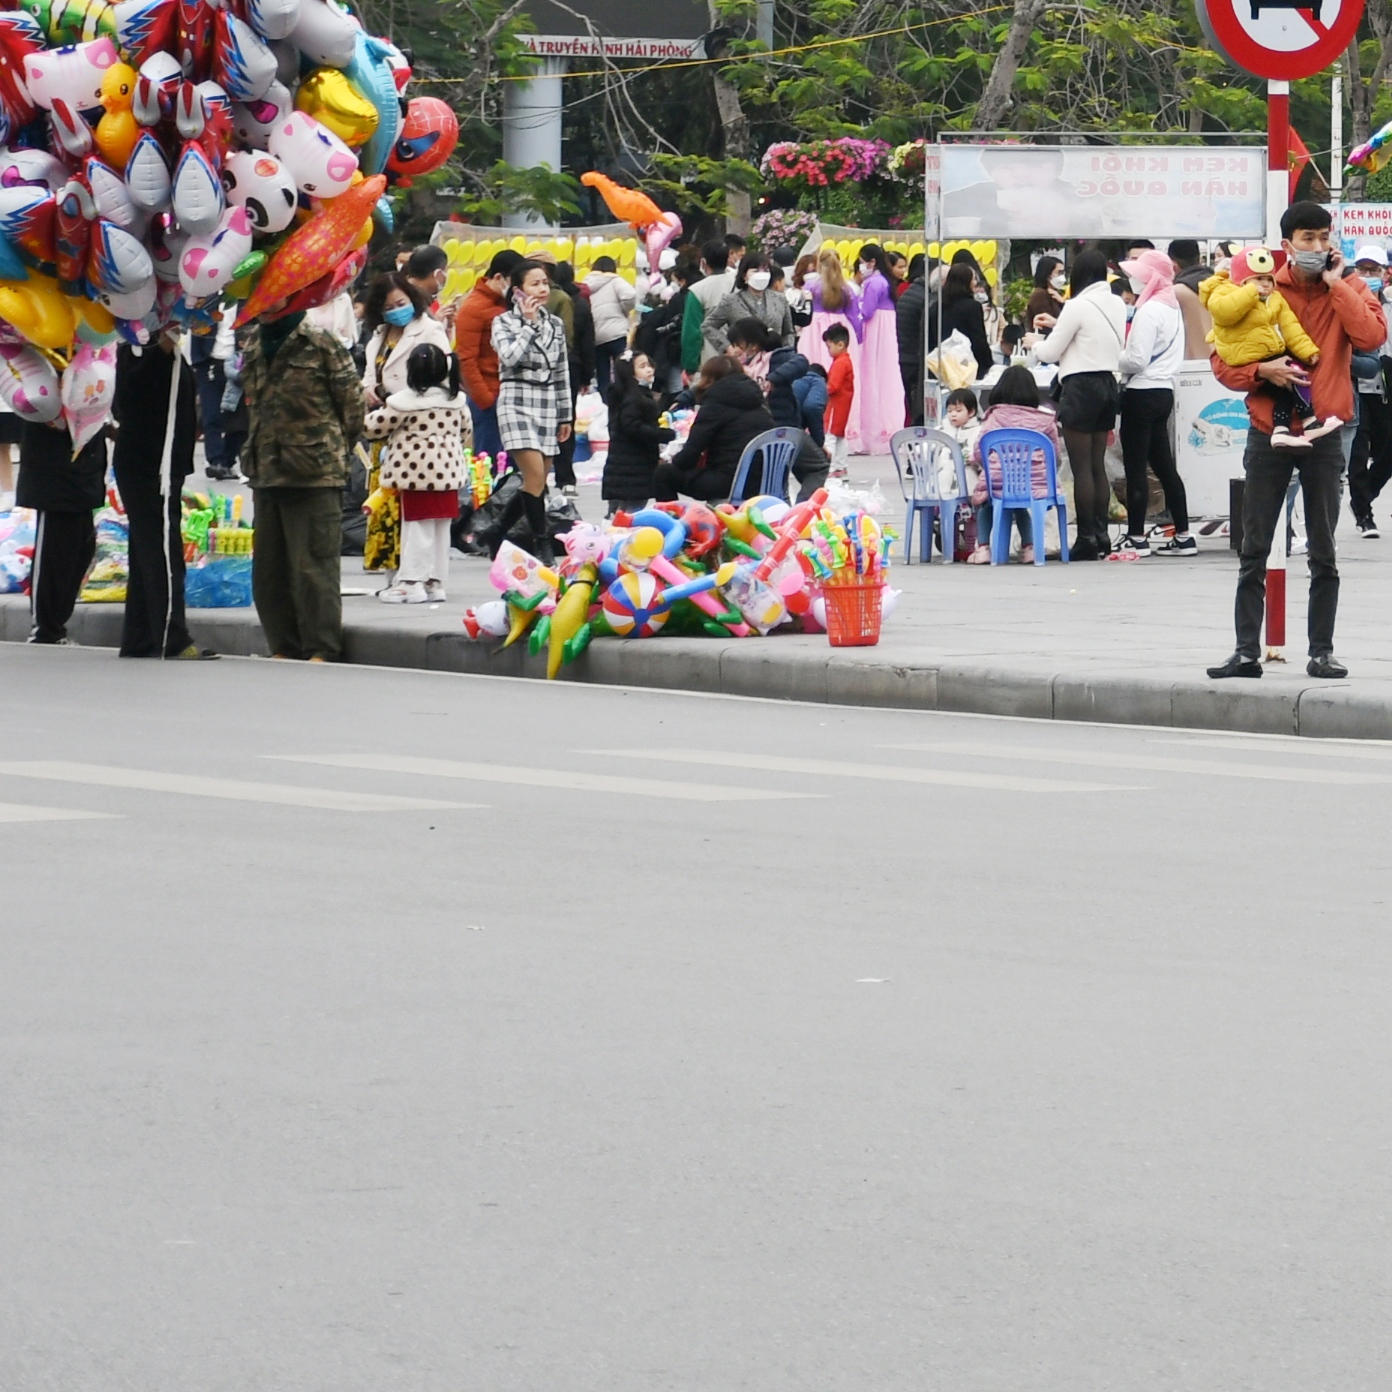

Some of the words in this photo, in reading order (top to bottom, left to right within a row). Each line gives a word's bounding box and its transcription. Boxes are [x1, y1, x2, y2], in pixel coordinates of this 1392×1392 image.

[592, 42, 622, 56] HNH
[625, 40, 648, 56] HẢI
[650, 41, 693, 58] PHÒNG
[1343, 209, 1364, 220] KEM
[1343, 222, 1364, 236] HÀN
